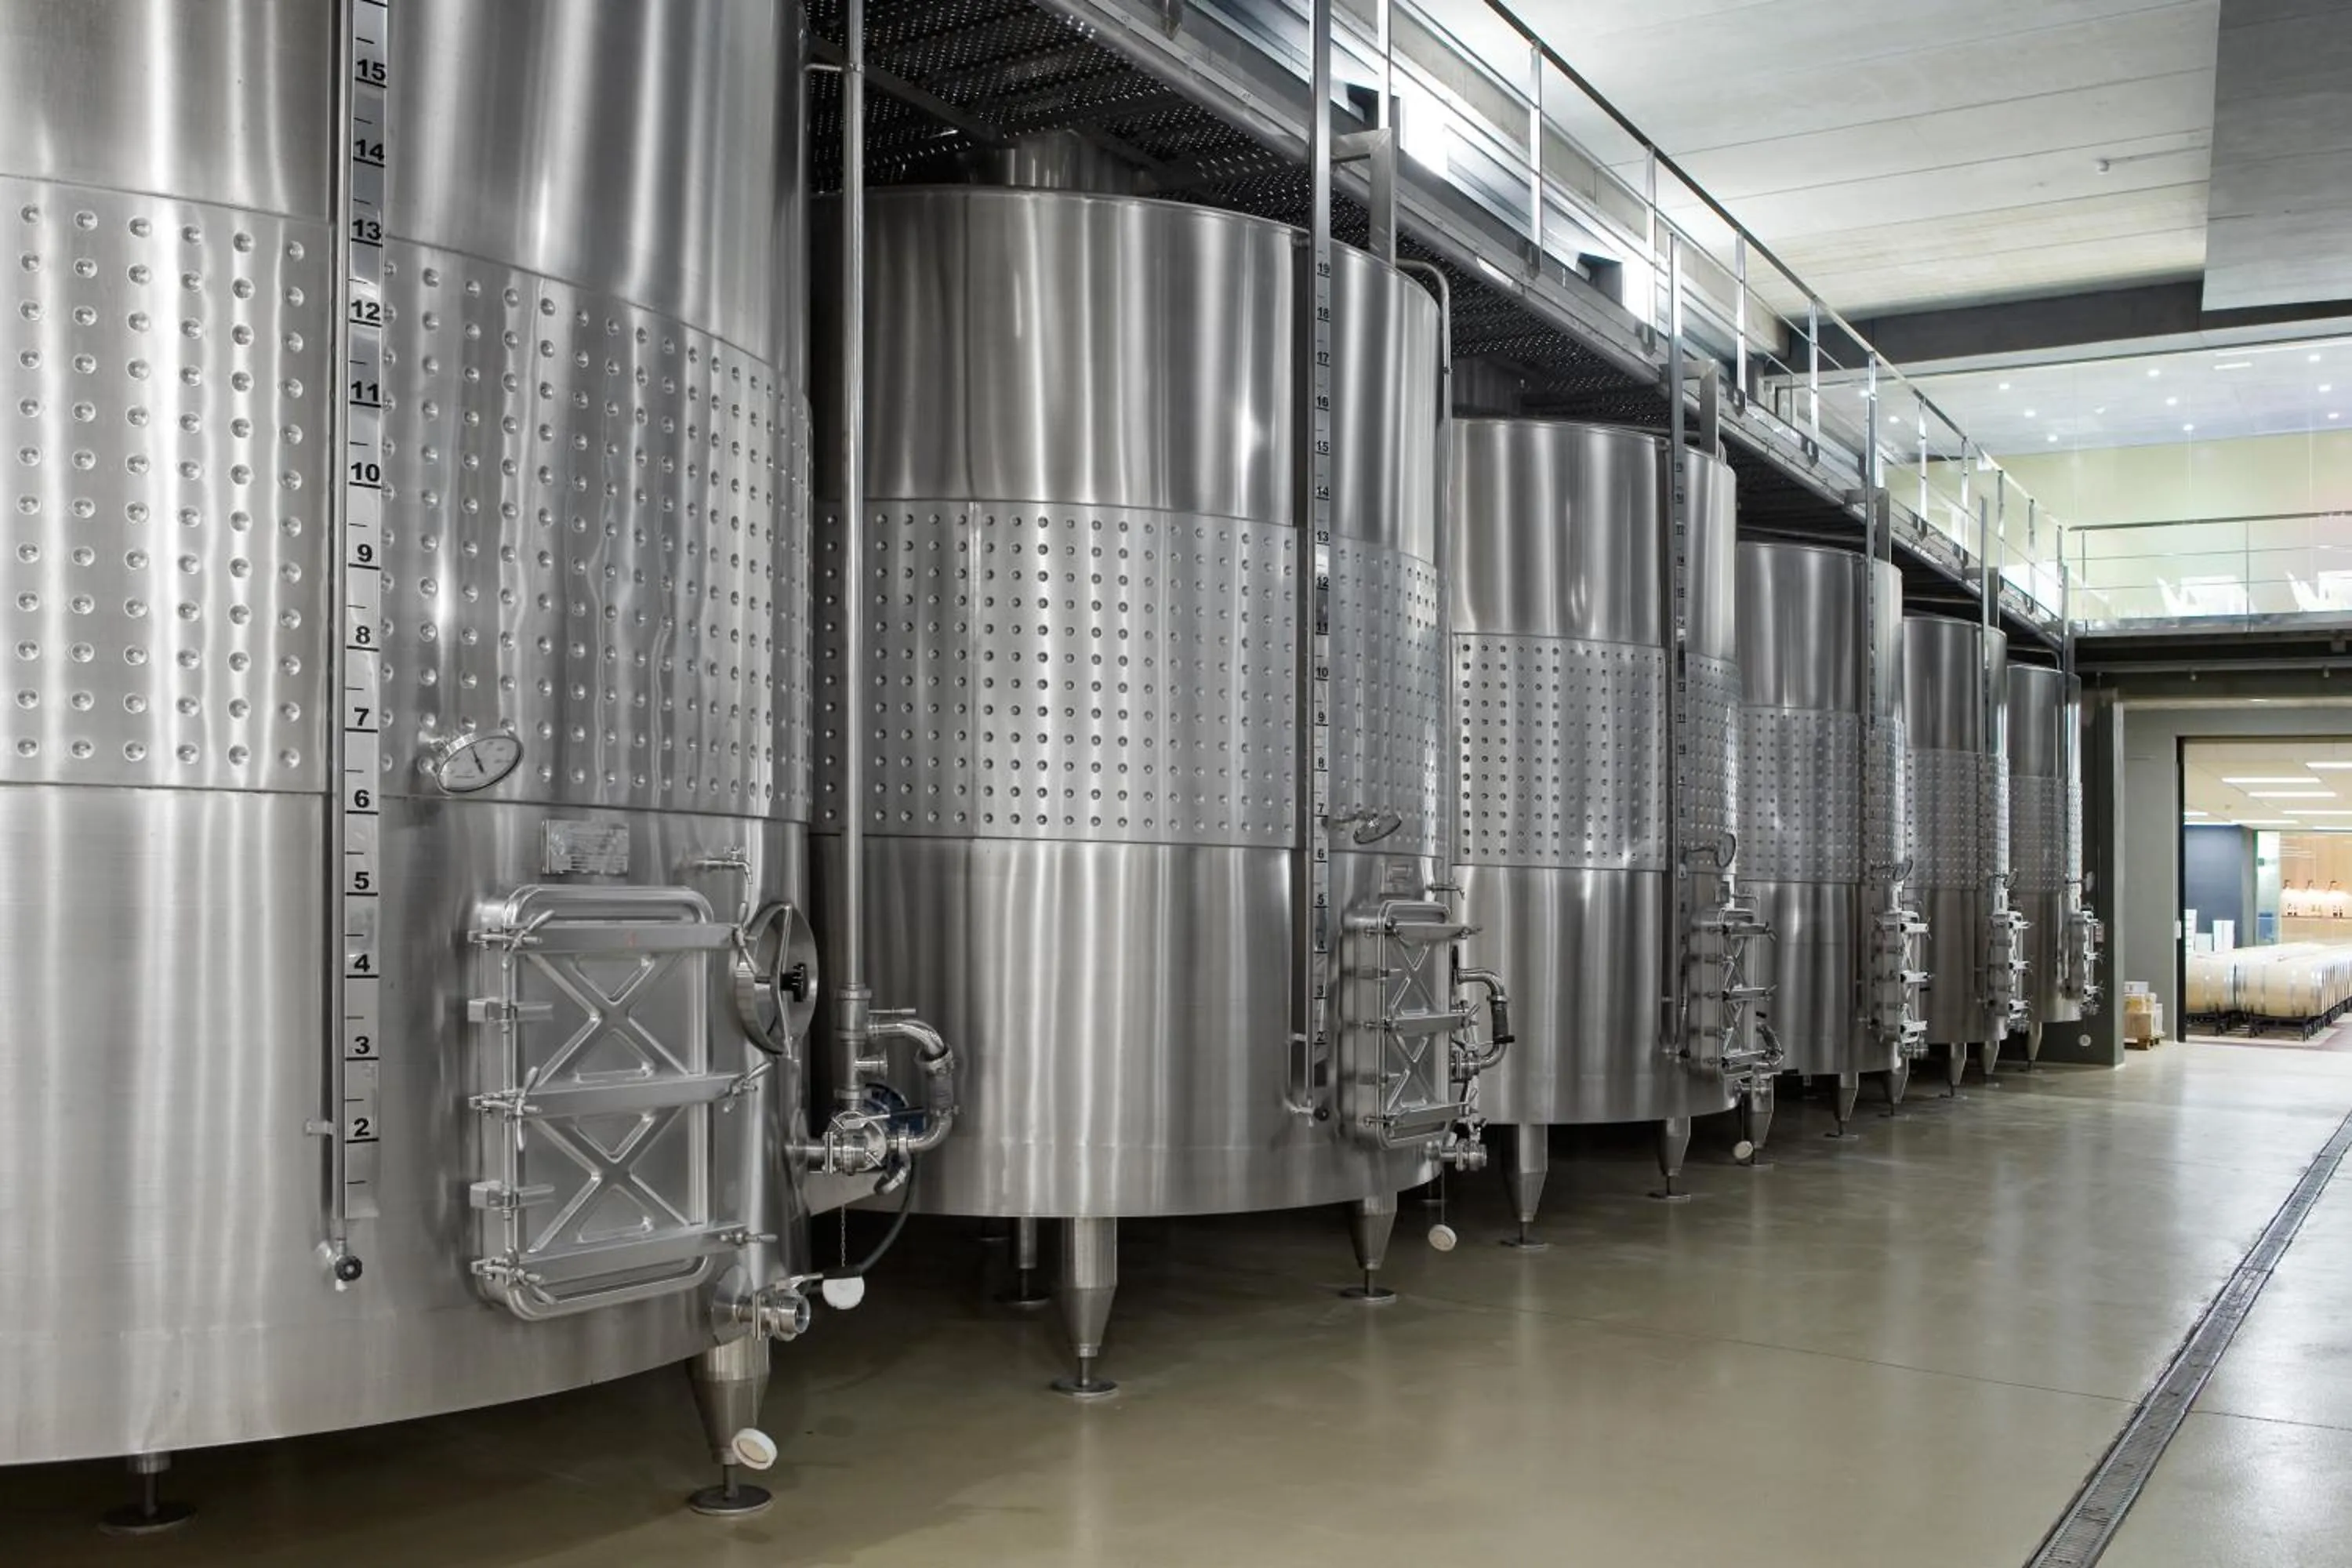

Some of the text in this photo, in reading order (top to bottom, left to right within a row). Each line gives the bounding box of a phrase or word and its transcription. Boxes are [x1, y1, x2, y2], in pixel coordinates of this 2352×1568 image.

[357, 59, 386, 80] 15
[355, 140, 384, 161] 14
[353, 220, 381, 240] 13
[1317, 263, 1330, 274] 19
[351, 299, 380, 321] 12
[1317, 307, 1329, 318] 18
[1317, 353, 1329, 363] 17
[351, 381, 379, 401] 11
[1317, 441, 1329, 452] 15
[350, 462, 380, 482] 10
[1317, 486, 1329, 496] 14
[1317, 531, 1329, 542] 13
[357, 544, 373, 562] 9
[1317, 577, 1329, 587] 12
[1317, 622, 1329, 632] 11
[356, 626, 371, 644] 8
[1316, 667, 1329, 677] 10
[354, 707, 369, 726] 7
[1318, 712, 1325, 722] 9
[1318, 757, 1325, 768] 8
[354, 789, 369, 808] 6
[1317, 803, 1324, 813] 7
[1317, 848, 1324, 858] 6
[354, 872, 369, 890] 5
[1317, 894, 1324, 905] 5
[354, 954, 370, 972] 4
[354, 1036, 370, 1054] 3
[354, 1118, 370, 1136] 2
